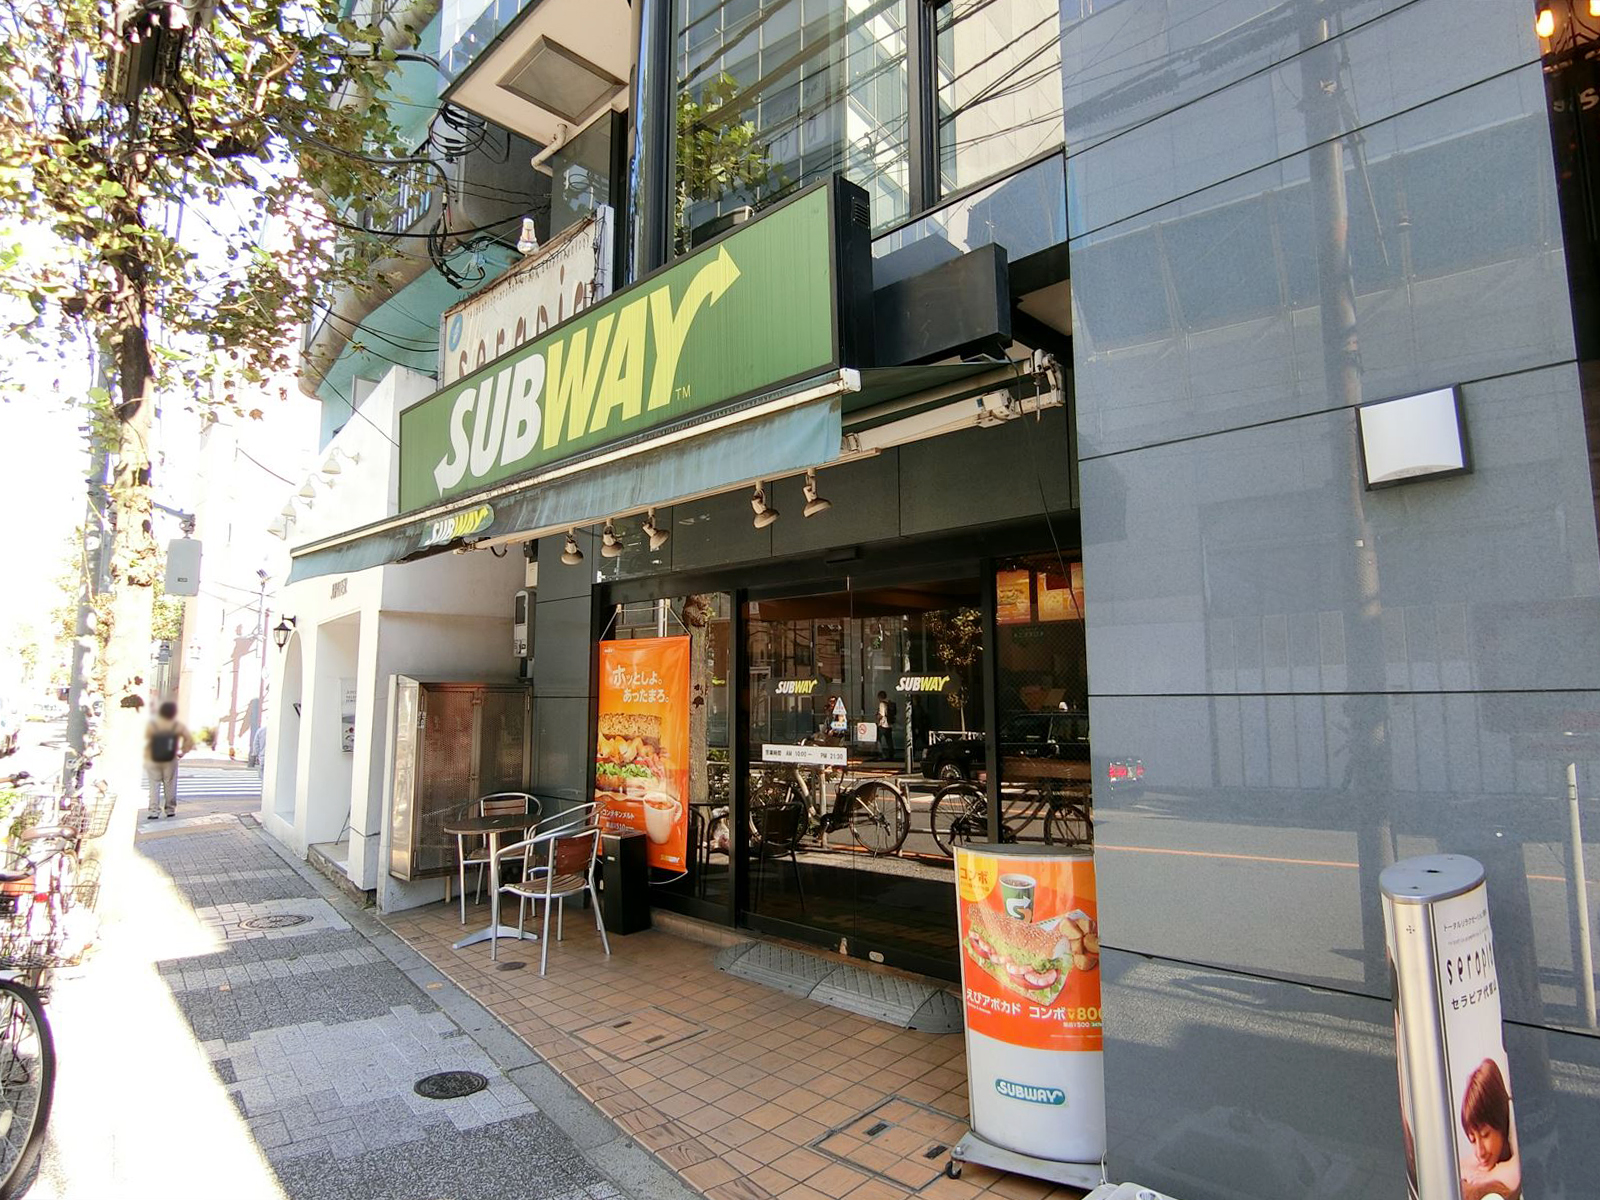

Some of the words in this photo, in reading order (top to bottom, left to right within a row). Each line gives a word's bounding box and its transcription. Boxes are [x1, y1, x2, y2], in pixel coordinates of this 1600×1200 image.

[433, 244, 742, 498] SUBWAY
[675, 384, 691, 400] TM
[423, 505, 489, 547] SUBWAY
[775, 679, 818, 694] SUBWAY
[896, 675, 950, 692] SUBWAY
[966, 988, 1022, 1016] えびアボカド
[1028, 1005, 1067, 1021] コンボ
[997, 1080, 1064, 1104] SUBWAY
